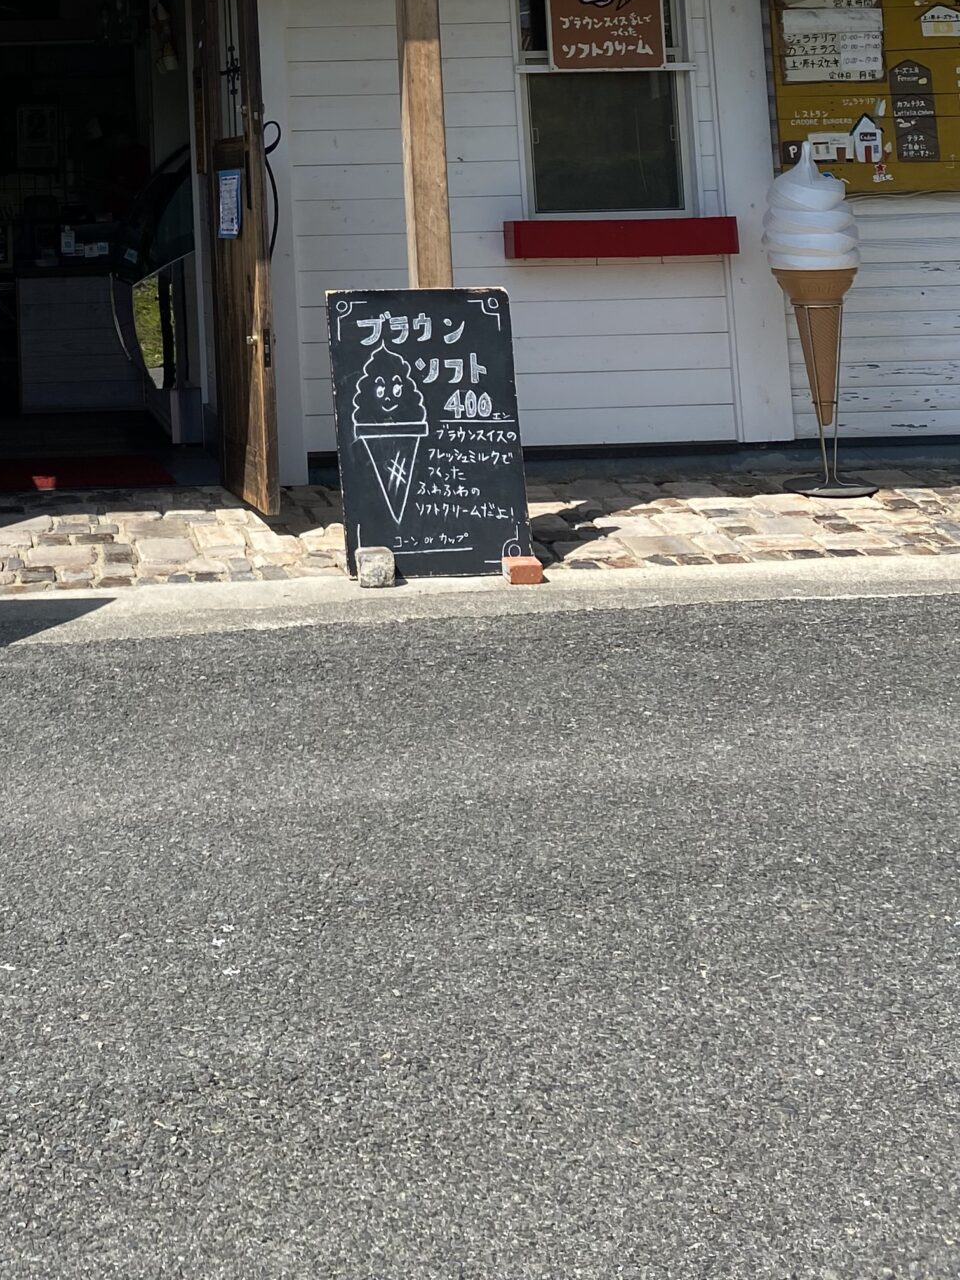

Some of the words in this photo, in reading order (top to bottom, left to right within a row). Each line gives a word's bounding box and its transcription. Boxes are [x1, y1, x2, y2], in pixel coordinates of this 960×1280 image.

[561, 35, 654, 59] ソフトクリーム
[794, 110, 829, 118] レストラン
[788, 145, 798, 159] P
[357, 311, 465, 345] ブラウン
[415, 353, 488, 383] ソフト
[436, 425, 517, 444] ブラウンスイスの
[428, 448, 514, 465] フレッシュミルクで
[428, 467, 467, 481] つくった
[417, 482, 481, 497] ふわふわの
[393, 536, 418, 548] コーン
[424, 535, 434, 544] or
[439, 532, 469, 545] カップ
